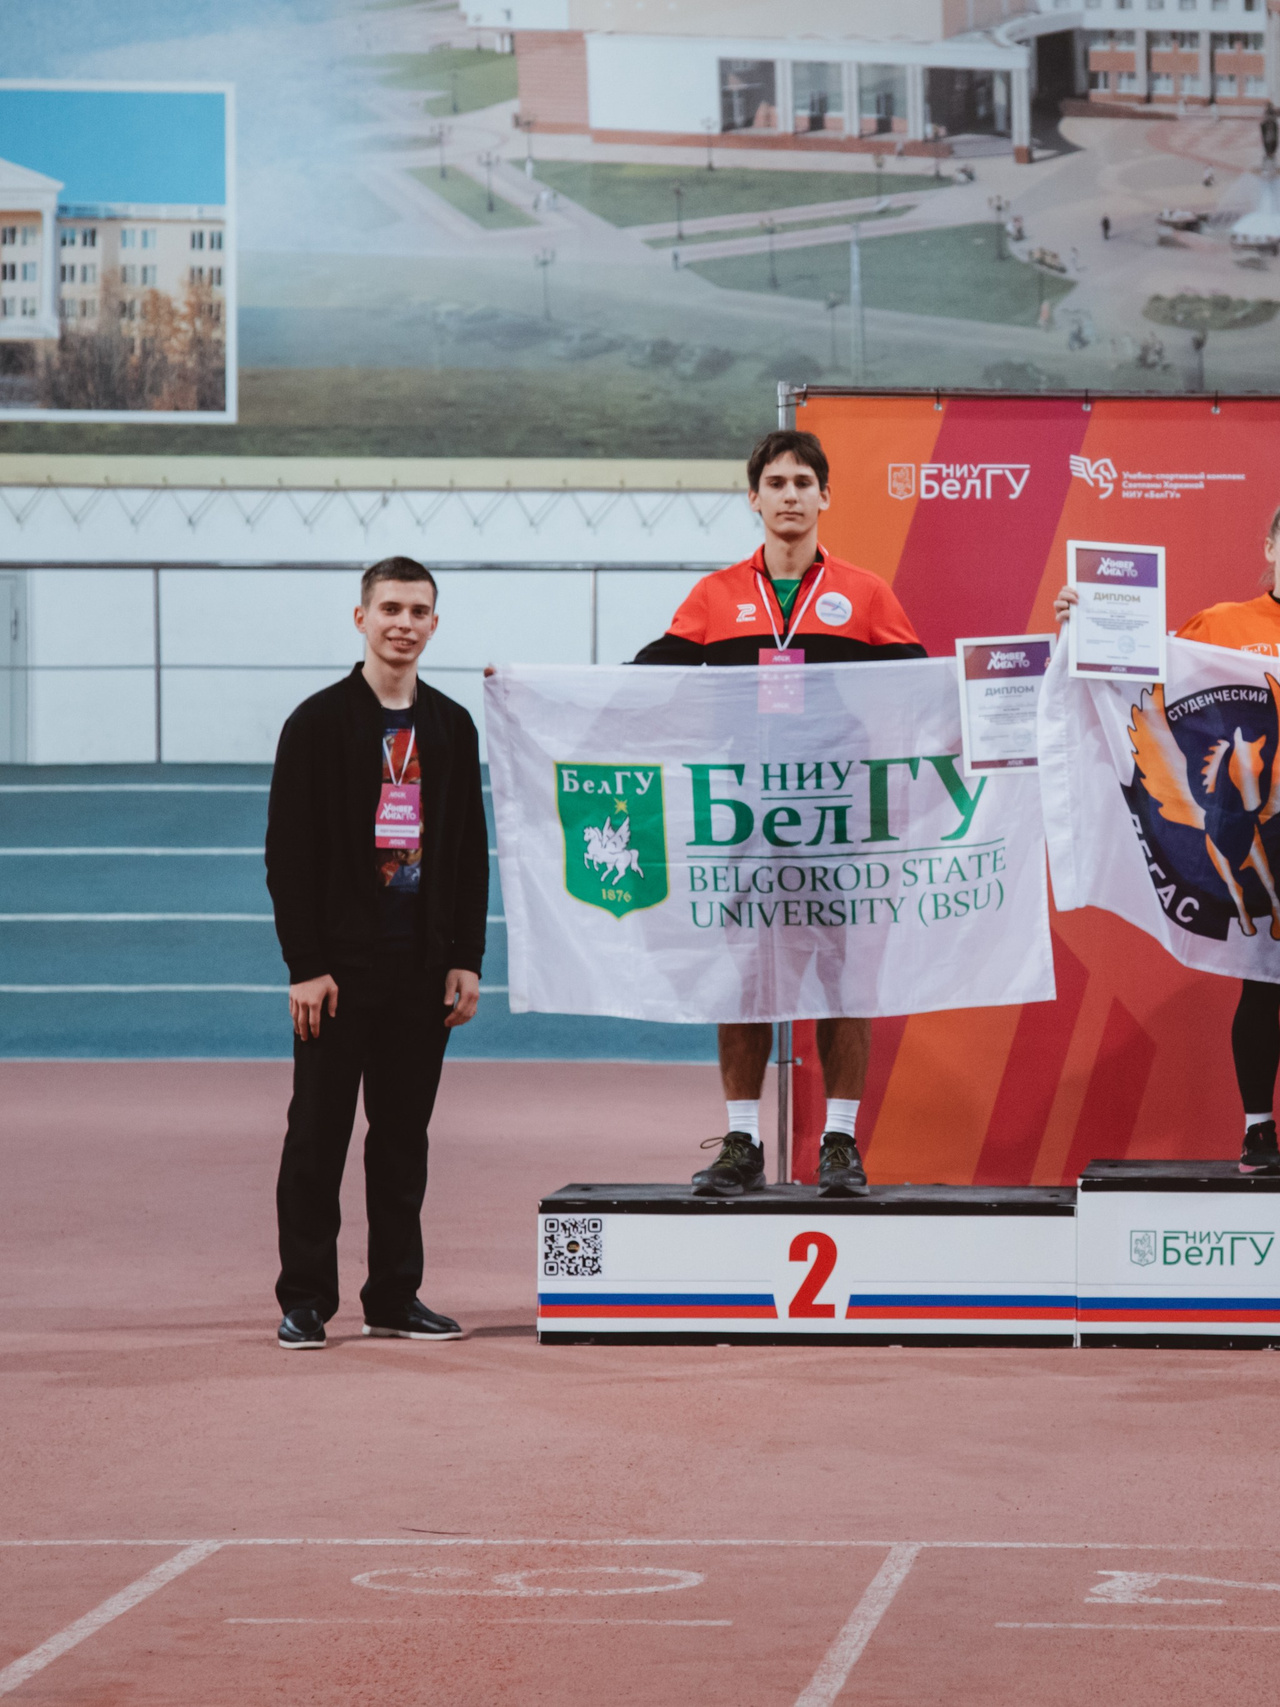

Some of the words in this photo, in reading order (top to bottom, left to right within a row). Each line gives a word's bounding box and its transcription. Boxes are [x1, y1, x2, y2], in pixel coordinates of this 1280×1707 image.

[920, 468, 1031, 499] БелГУ
[942, 464, 980, 478] НИУ
[1122, 490, 1142, 498] НИУ
[1093, 592, 1141, 602] ДИПЛОМ
[984, 685, 1035, 696] ДИПЛОМ
[1167, 689, 1269, 721] СТУДЕНЧЕСКИЙ
[560, 769, 655, 795] БелГУ
[760, 761, 855, 791] НИУ
[682, 753, 988, 847] БелГУ
[688, 862, 891, 894] BELGOROD
[902, 846, 1006, 887] STATE
[601, 888, 632, 903] 1876
[690, 895, 907, 929] UNIVERSITY
[918, 878, 1005, 927] (BSU)
[1163, 1236, 1275, 1266] БелГУ
[1185, 1231, 1225, 1245] НИУ
[788, 1231, 838, 1319] 2
